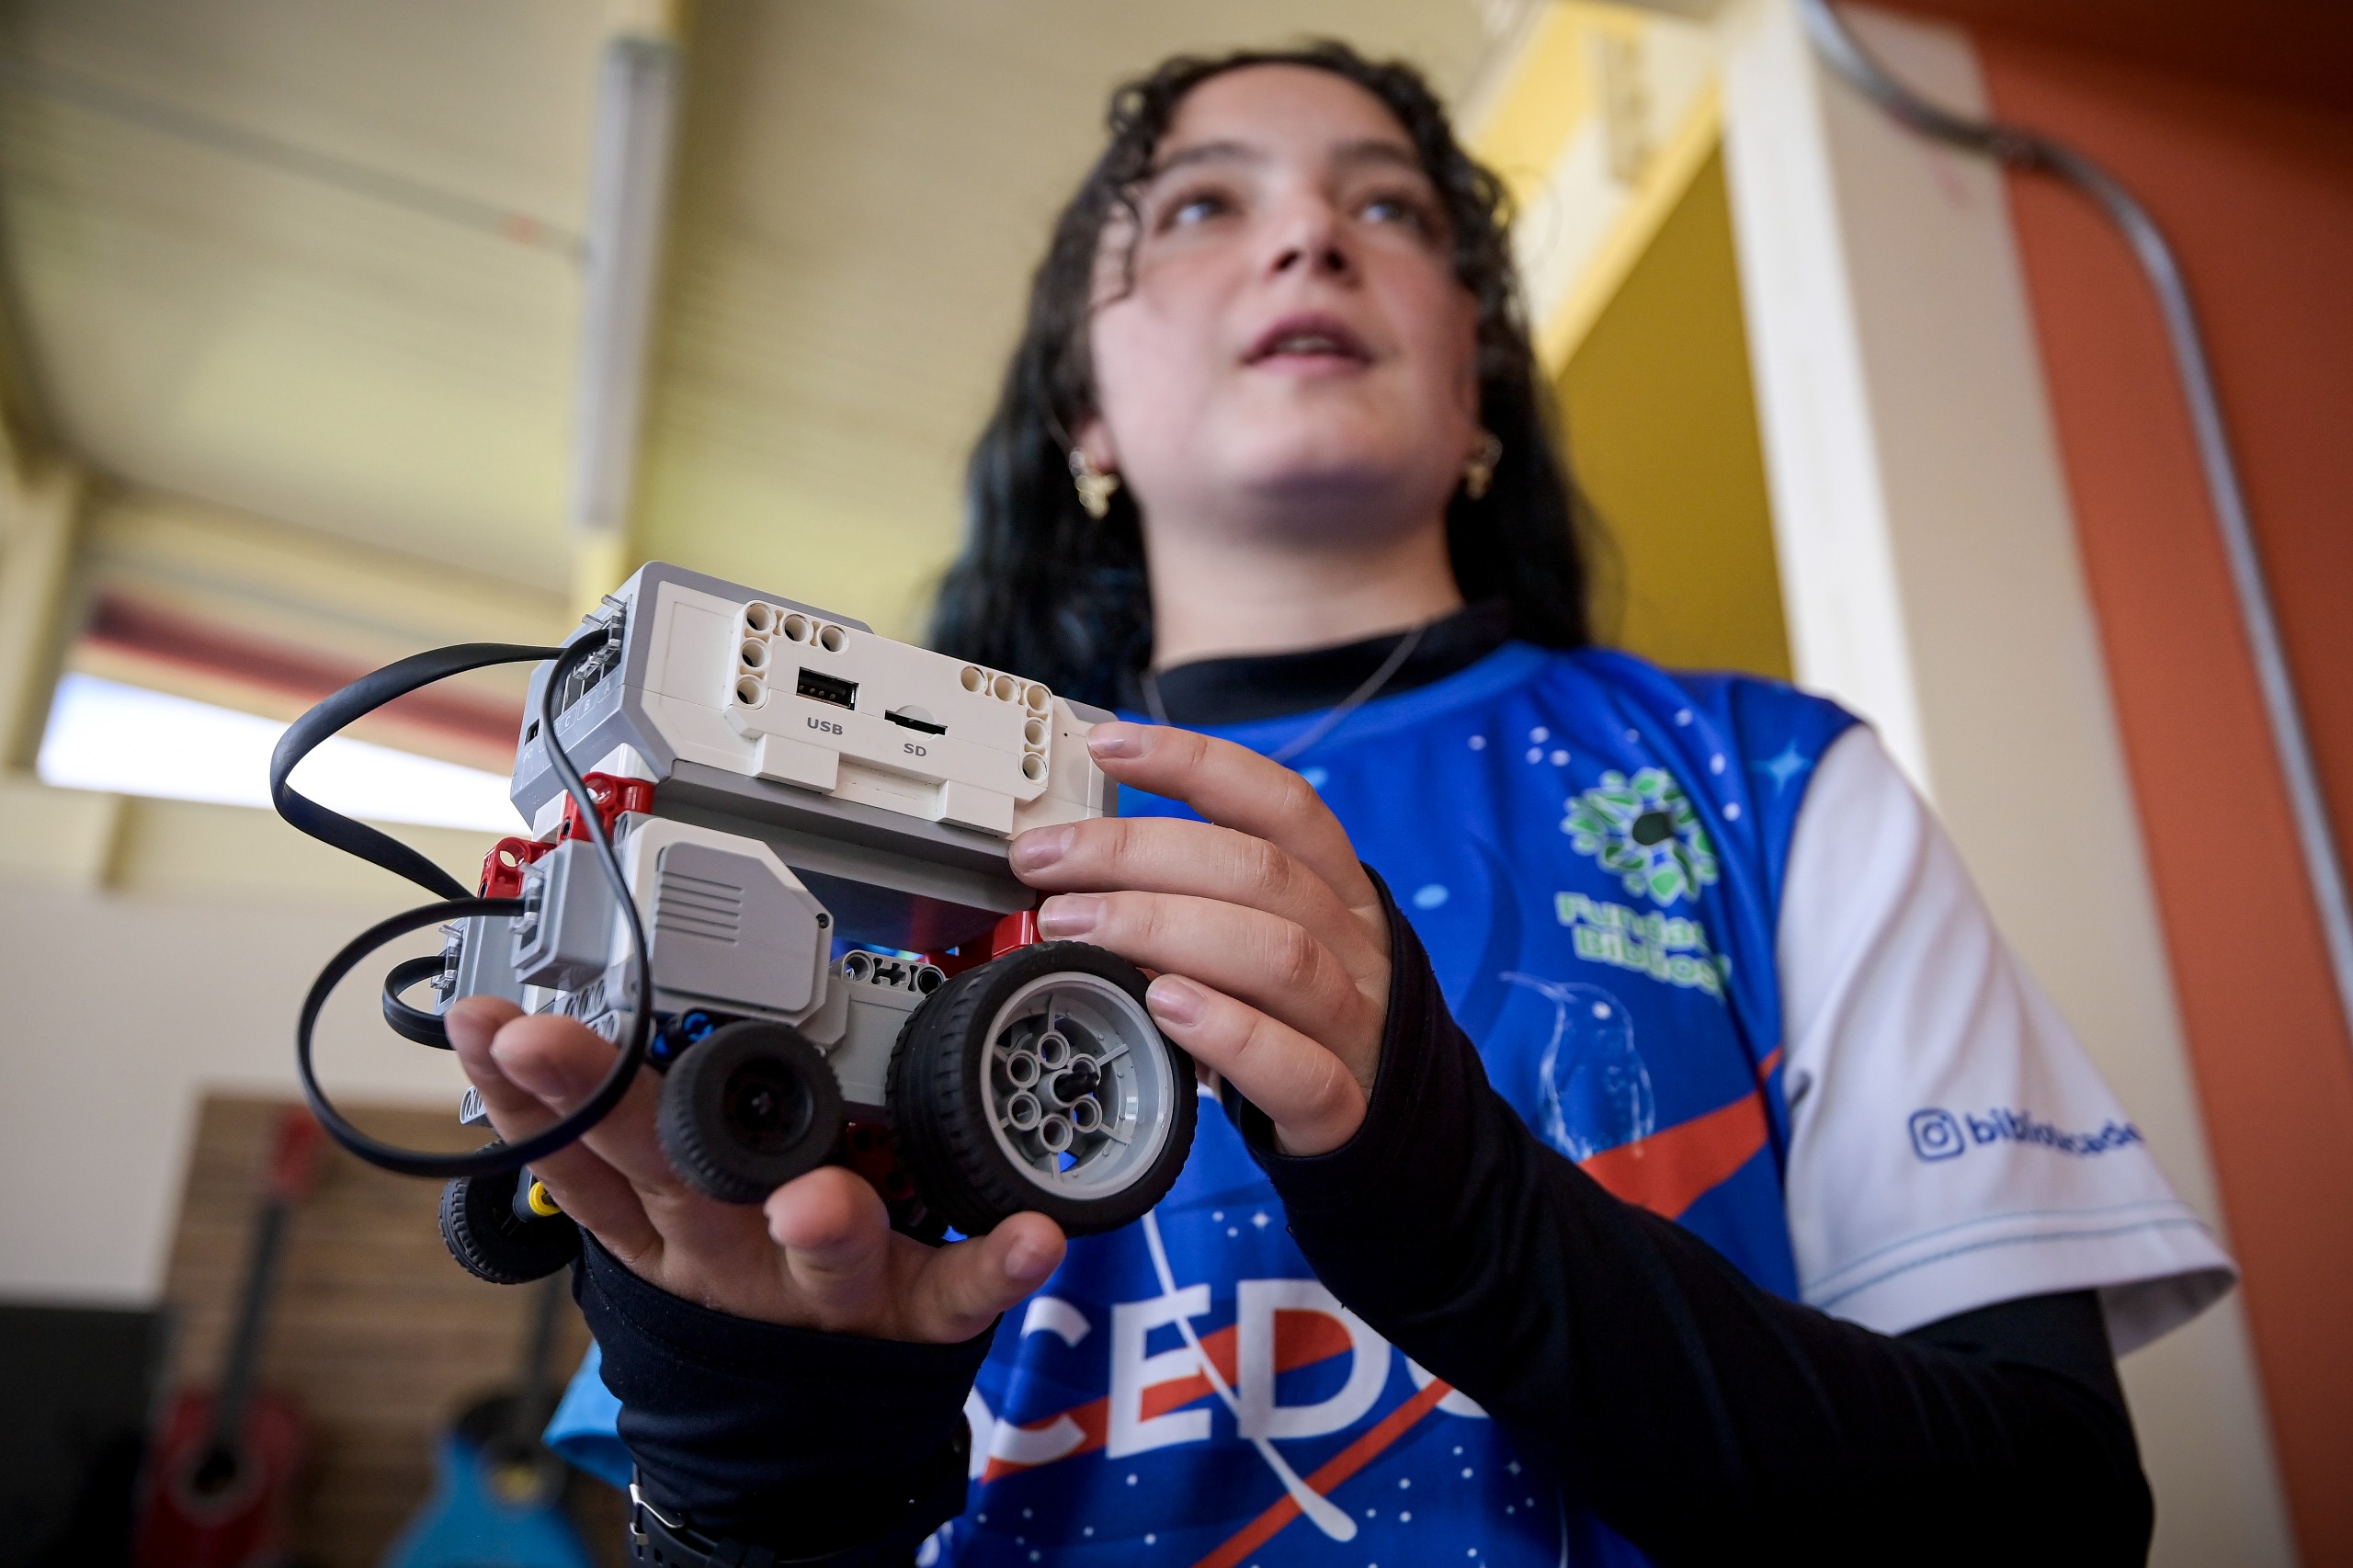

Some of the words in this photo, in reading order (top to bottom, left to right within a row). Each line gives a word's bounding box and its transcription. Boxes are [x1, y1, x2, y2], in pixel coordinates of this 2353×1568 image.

[807, 717, 843, 735] USB
[903, 743, 927, 757] SD
[965, 1278, 1490, 1480] CED
